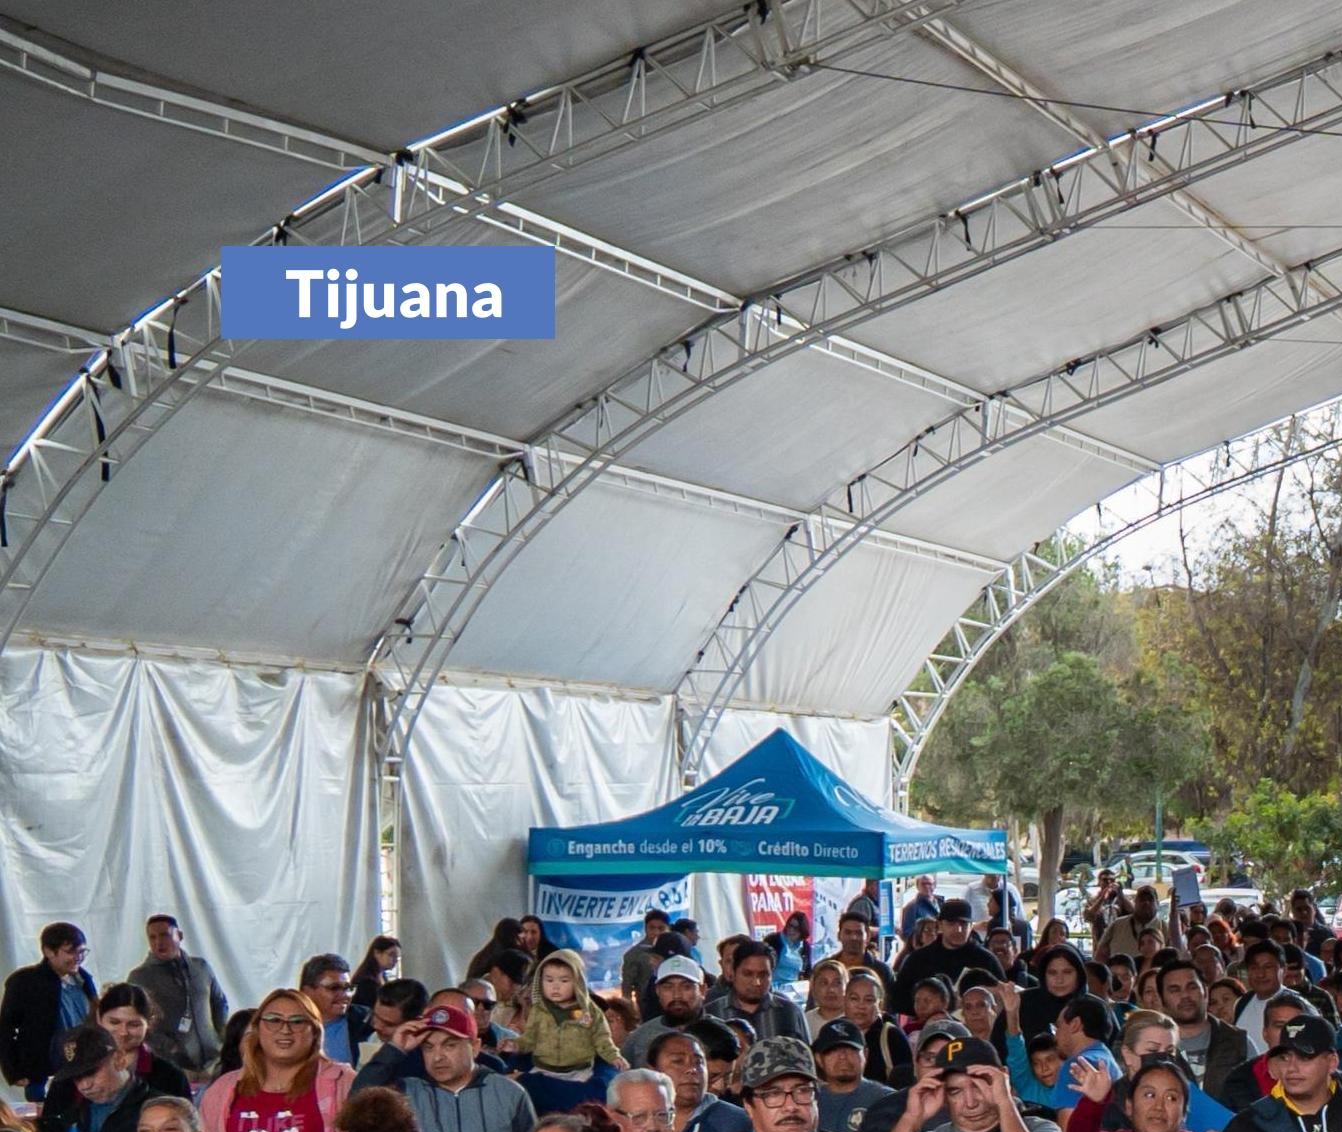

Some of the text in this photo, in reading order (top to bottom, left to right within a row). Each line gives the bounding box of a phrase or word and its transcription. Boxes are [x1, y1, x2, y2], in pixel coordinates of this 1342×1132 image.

[698, 806, 779, 826] BAJA
[568, 839, 727, 857] Enganche desde el 10%
[758, 840, 859, 858] Crédito Directo
[889, 840, 937, 862] TERRENOS
[541, 890, 616, 918] INVIERTE
[617, 896, 635, 917] EN
[751, 892, 782, 911] PARA
[948, 1041, 963, 1062] P
